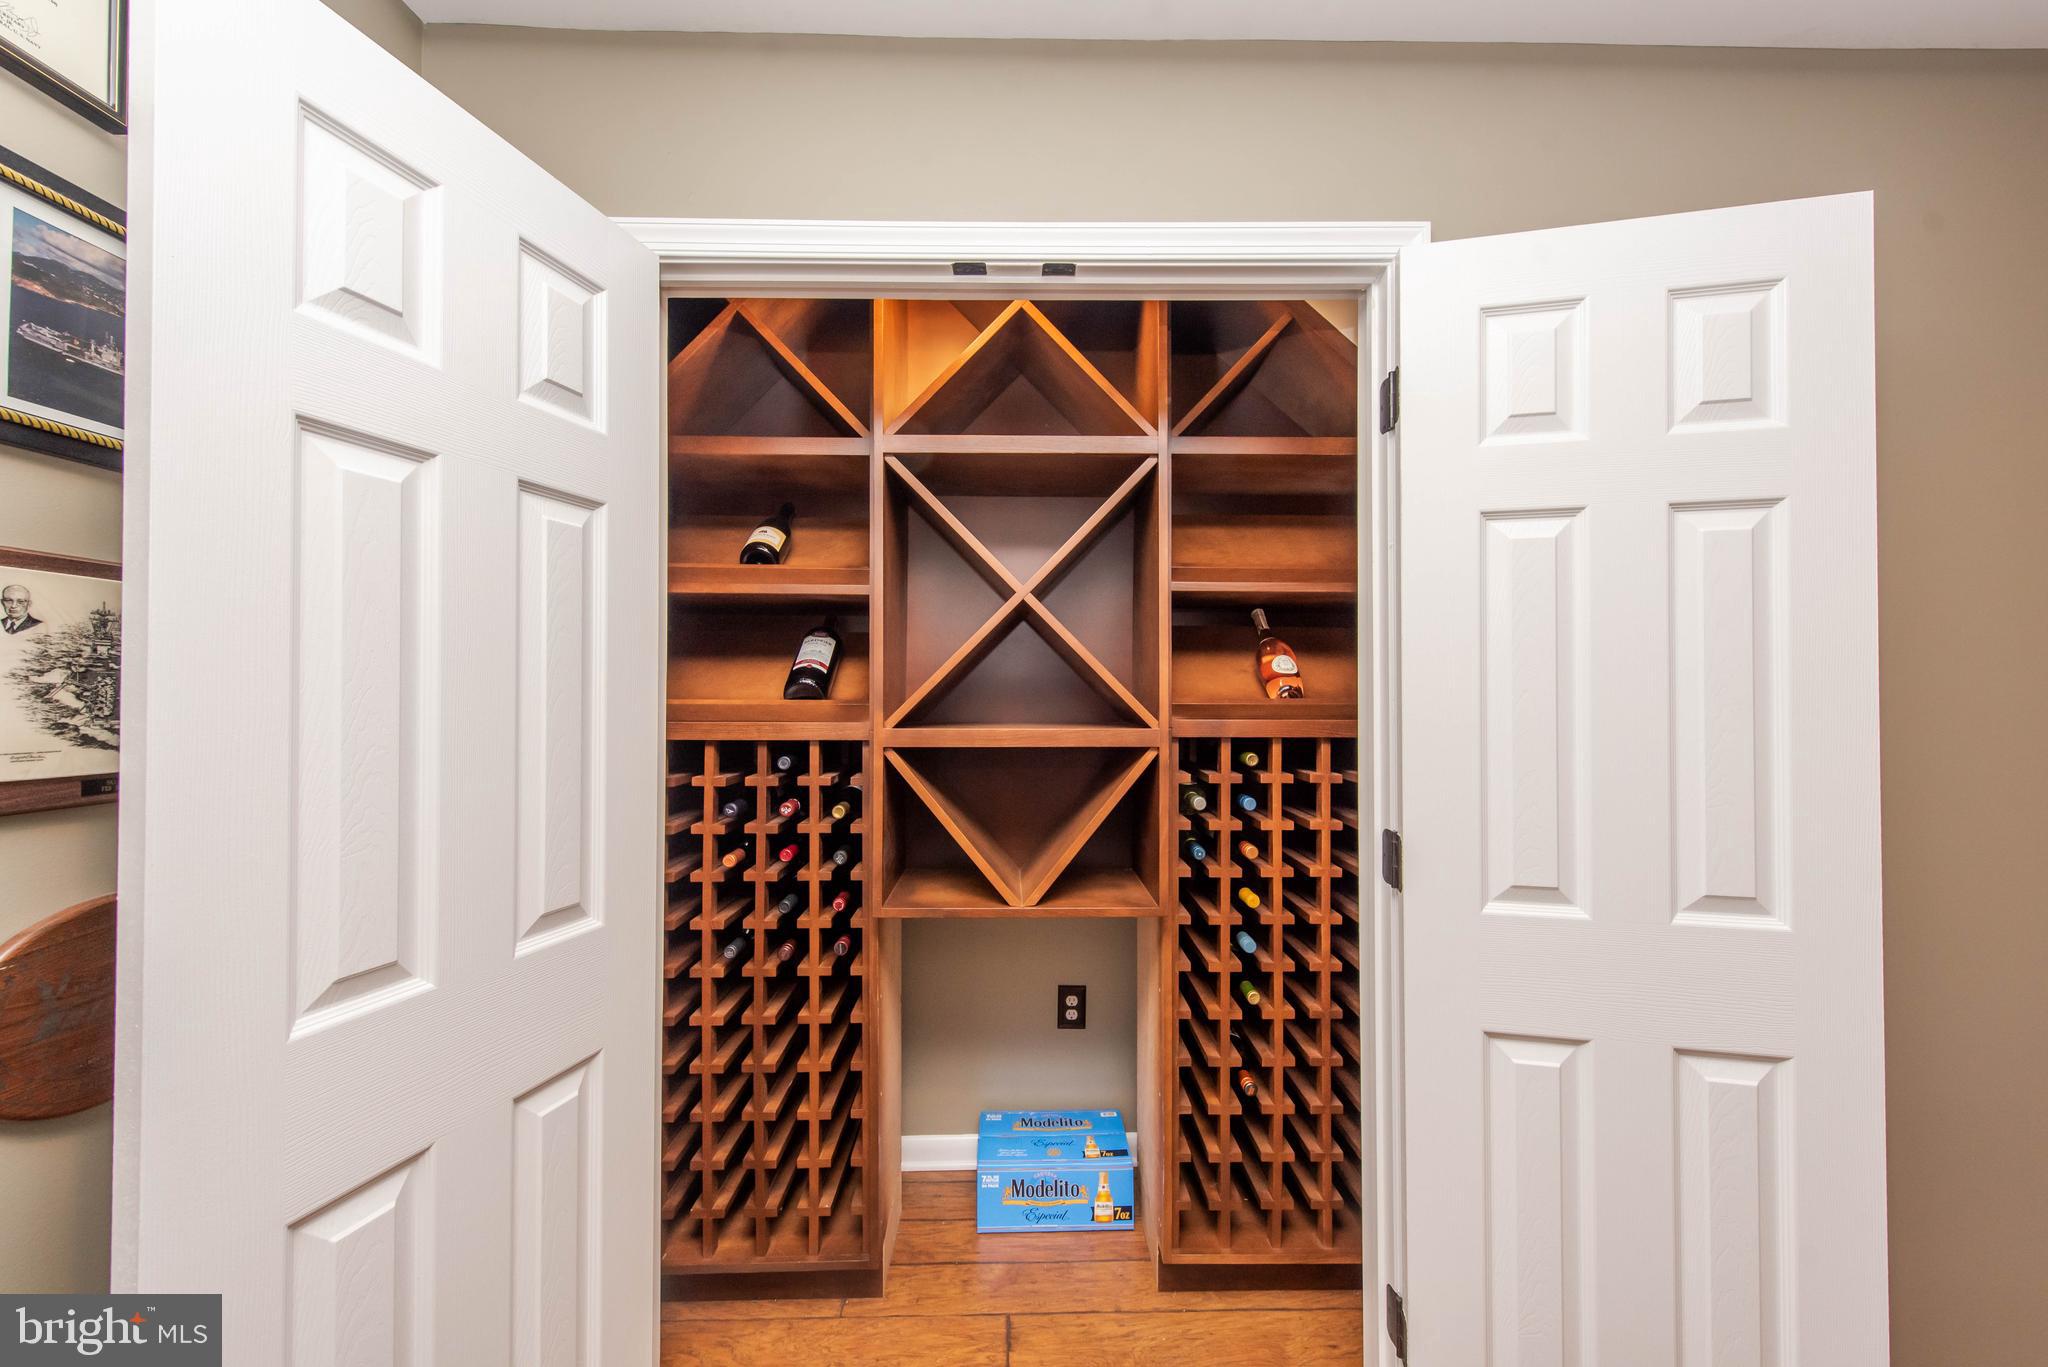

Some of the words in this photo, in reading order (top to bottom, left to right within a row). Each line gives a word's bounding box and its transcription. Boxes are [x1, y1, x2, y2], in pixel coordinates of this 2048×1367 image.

[1020, 1117, 1083, 1129] Modelito
[1011, 1179, 1080, 1198] Modelito
[1022, 1207, 1069, 1224] Especial
